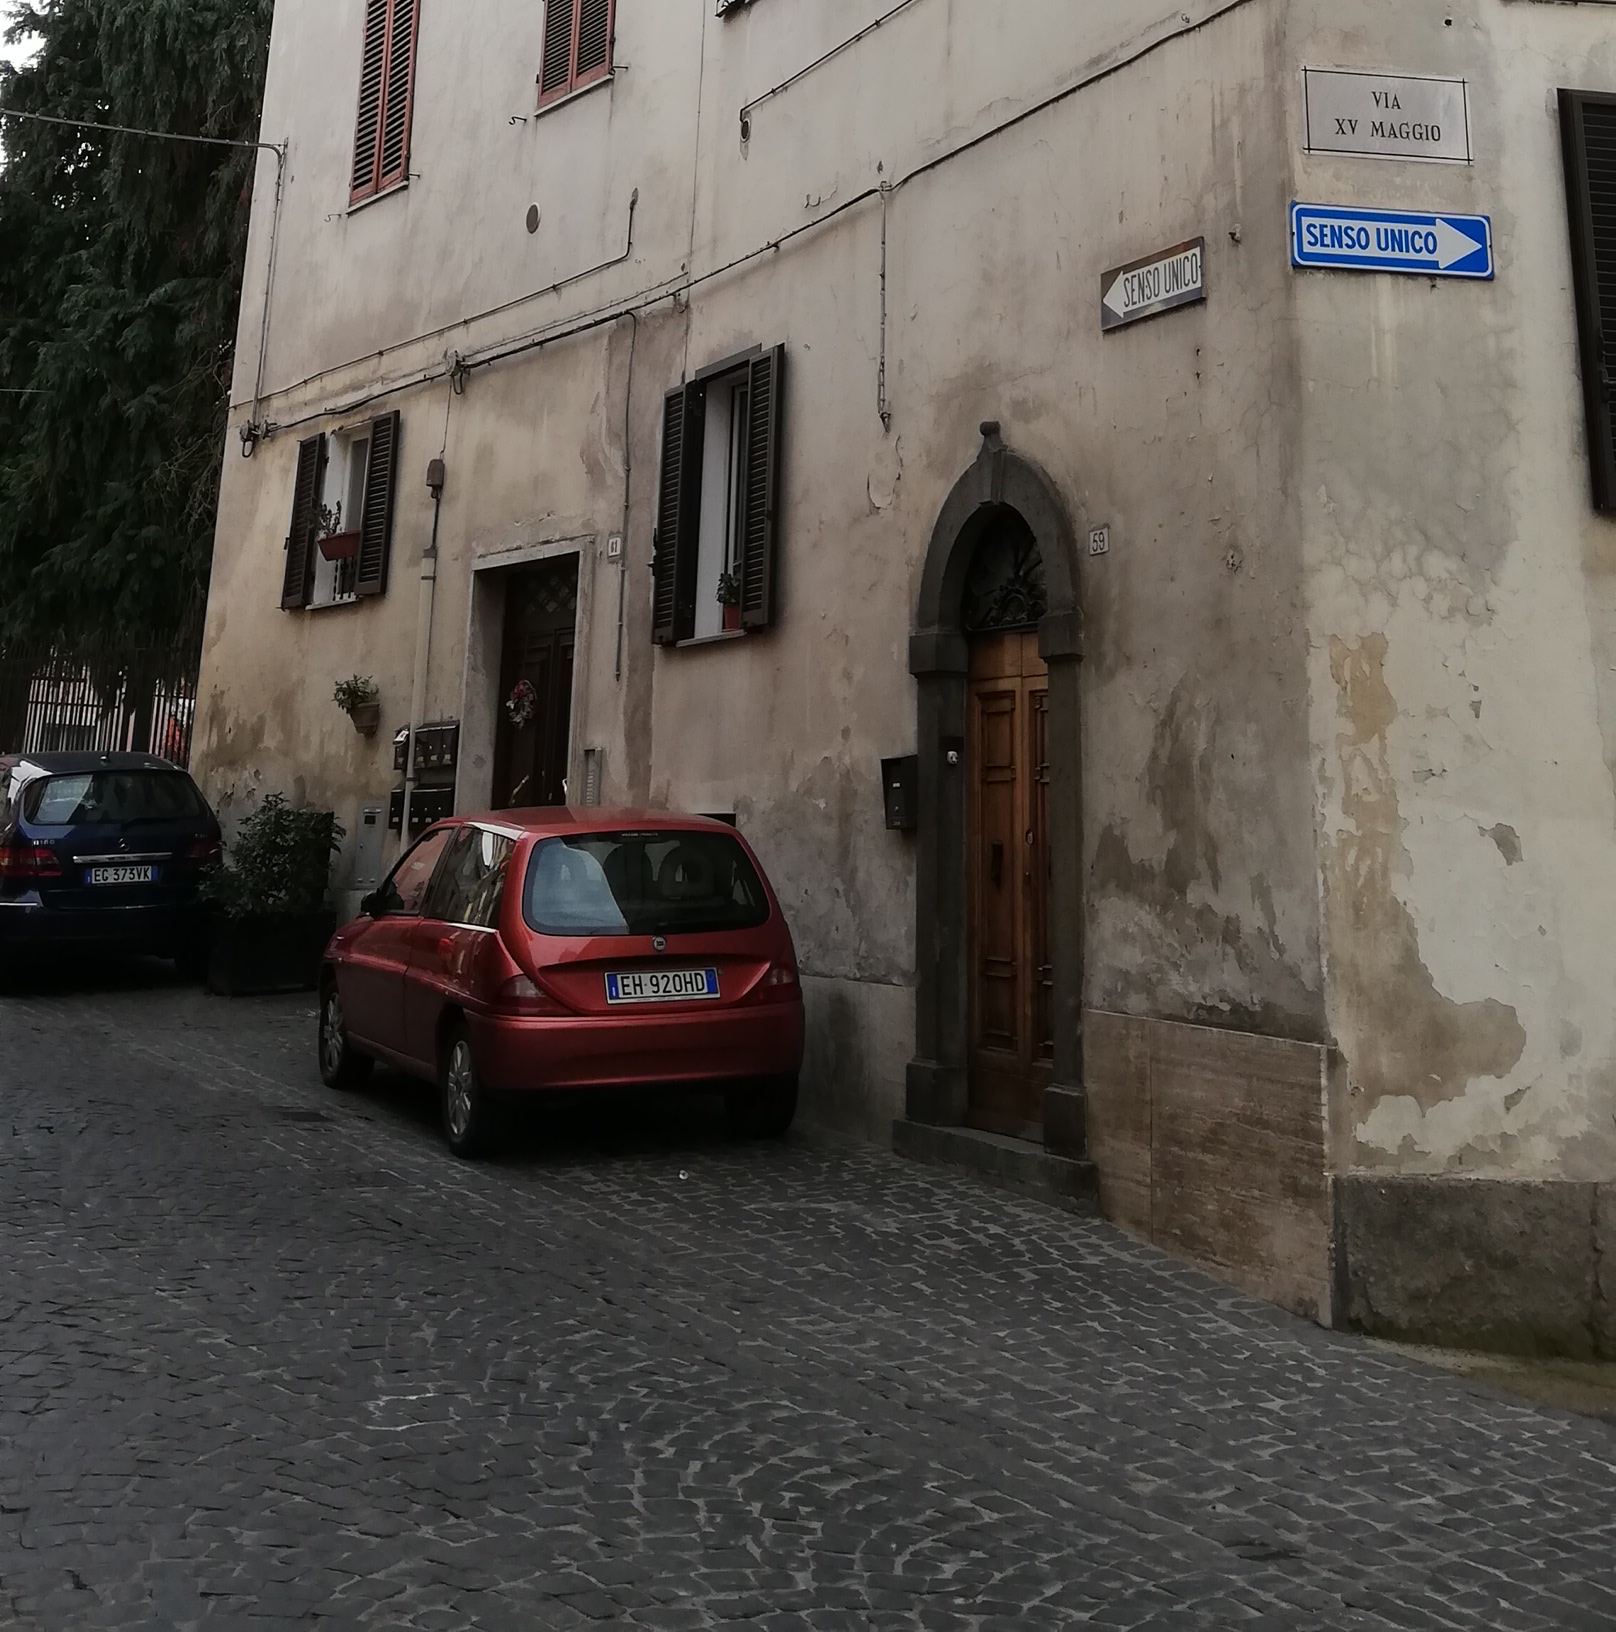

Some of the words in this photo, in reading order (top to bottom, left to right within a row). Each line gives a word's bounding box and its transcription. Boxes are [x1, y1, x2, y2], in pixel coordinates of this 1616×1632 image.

[1371, 91, 1402, 110] VIA
[1334, 118, 1358, 135] XV
[1370, 121, 1441, 142] MAGGIO
[1306, 223, 1370, 251] SENSO
[1376, 227, 1438, 255] UNICO
[1123, 266, 1160, 308] SENSO
[1163, 253, 1199, 294] UNICO
[1092, 531, 1105, 552] 59
[94, 869, 109, 882] EG
[113, 866, 151, 881] 373VK
[649, 972, 705, 994] 920HD
